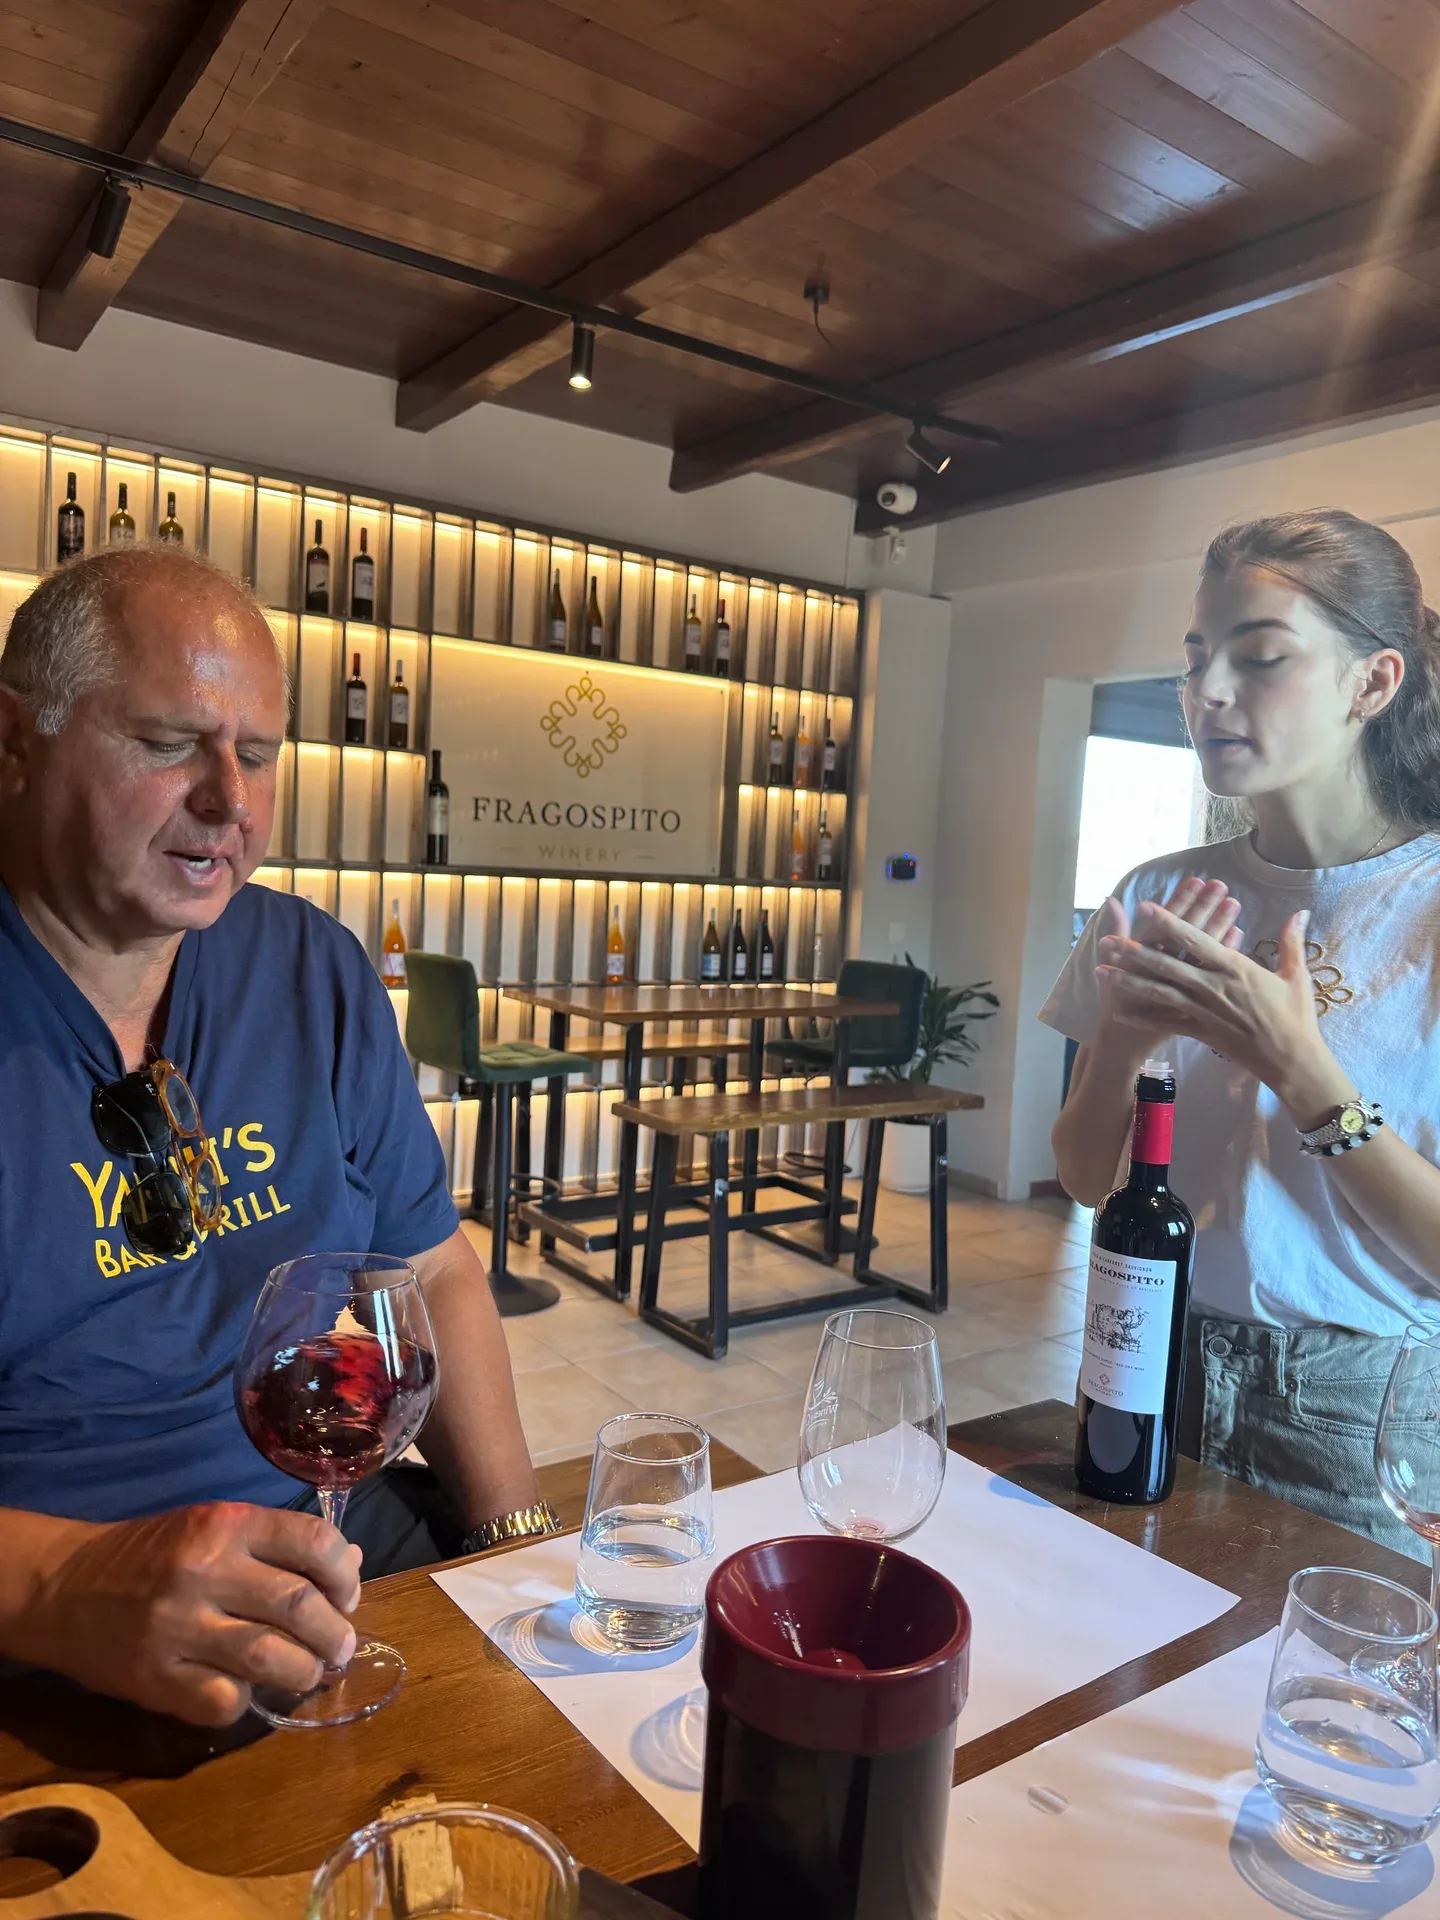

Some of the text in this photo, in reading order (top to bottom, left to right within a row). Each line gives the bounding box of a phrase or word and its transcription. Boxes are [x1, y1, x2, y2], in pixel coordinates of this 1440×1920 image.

[472, 796, 682, 834] FRAGOSPITO
[538, 844, 622, 863] WINERY
[69, 1122, 276, 1229] YAI'S
[1090, 1260, 1164, 1286] RAGOSPITO
